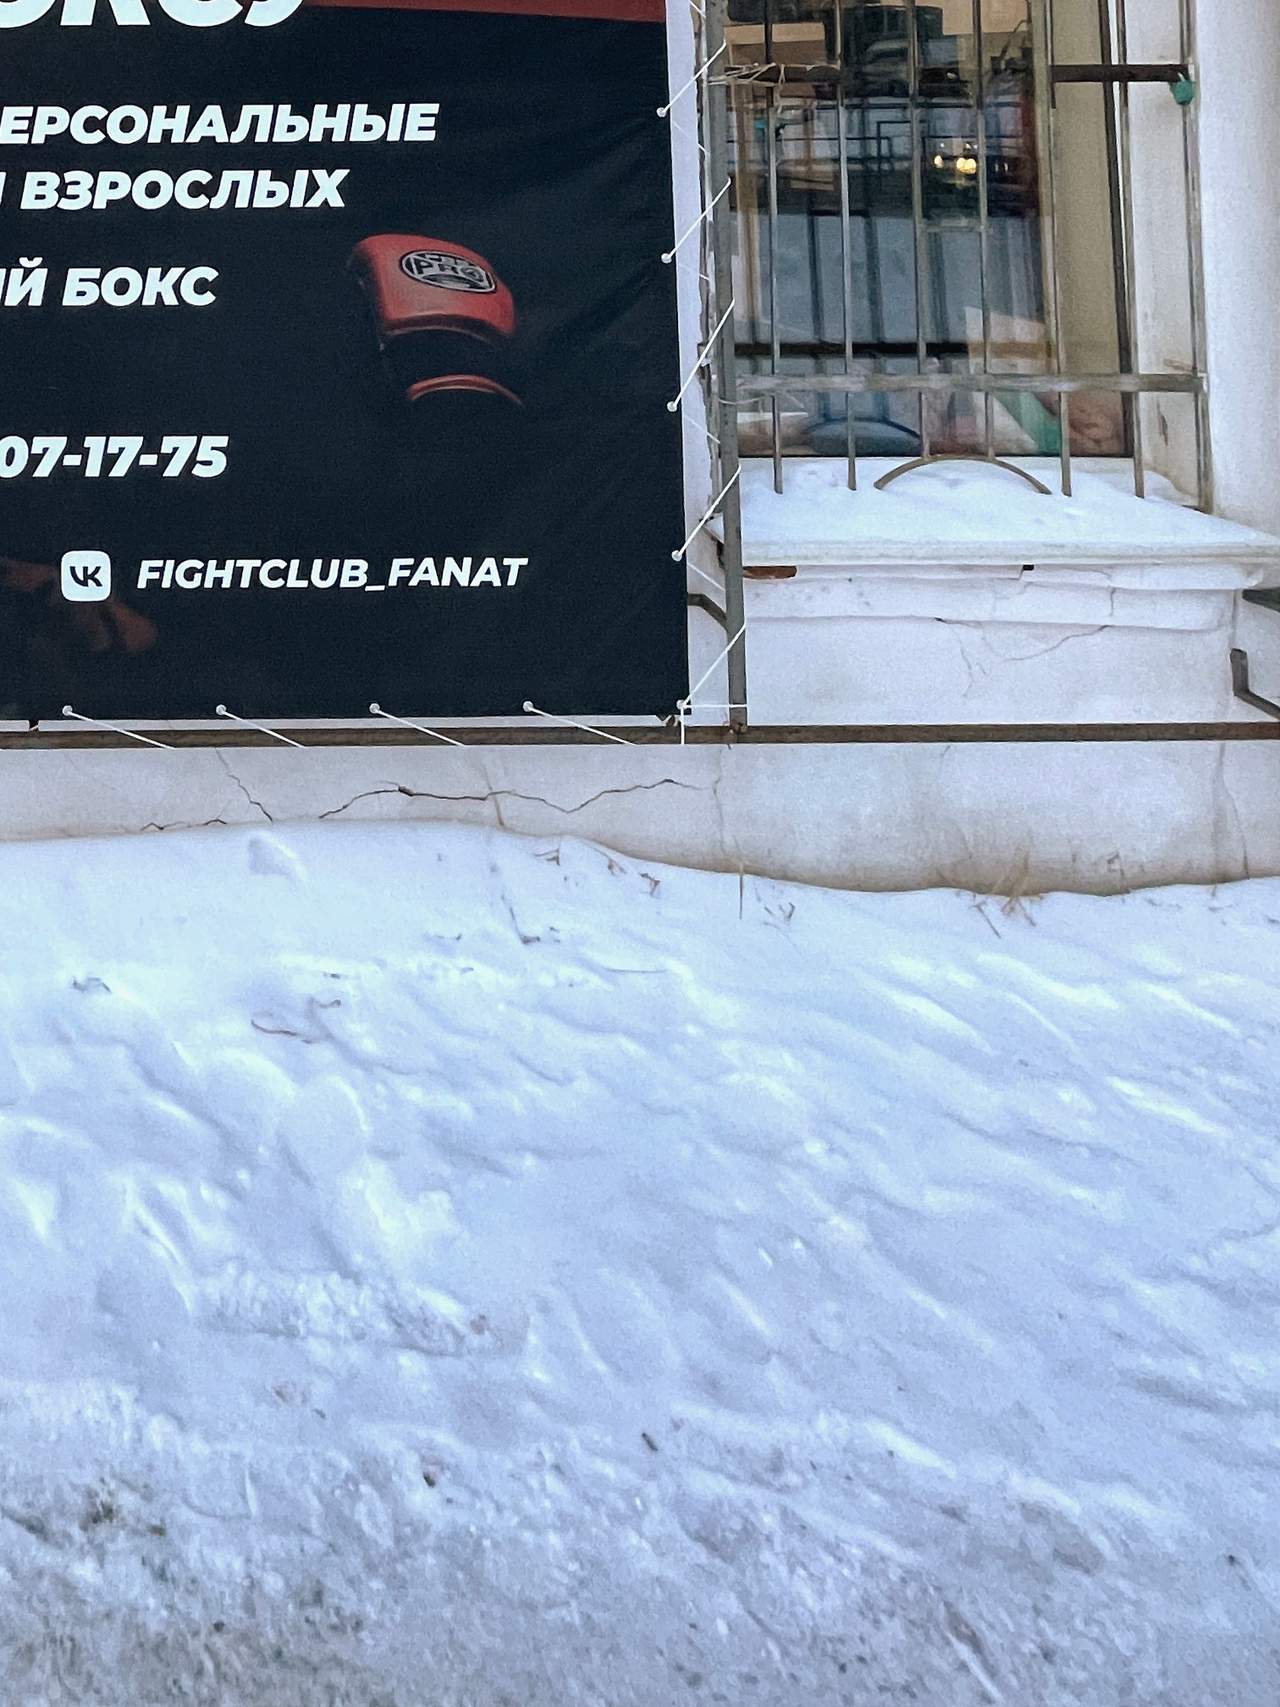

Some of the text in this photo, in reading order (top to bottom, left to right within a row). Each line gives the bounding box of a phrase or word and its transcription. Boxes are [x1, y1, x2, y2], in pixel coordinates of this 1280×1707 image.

[19, 168, 350, 212] ВЗРОСЛЫХ
[62, 265, 218, 307] БОКС
[137, 556, 530, 592] FIGHTCLUB_FANAT
